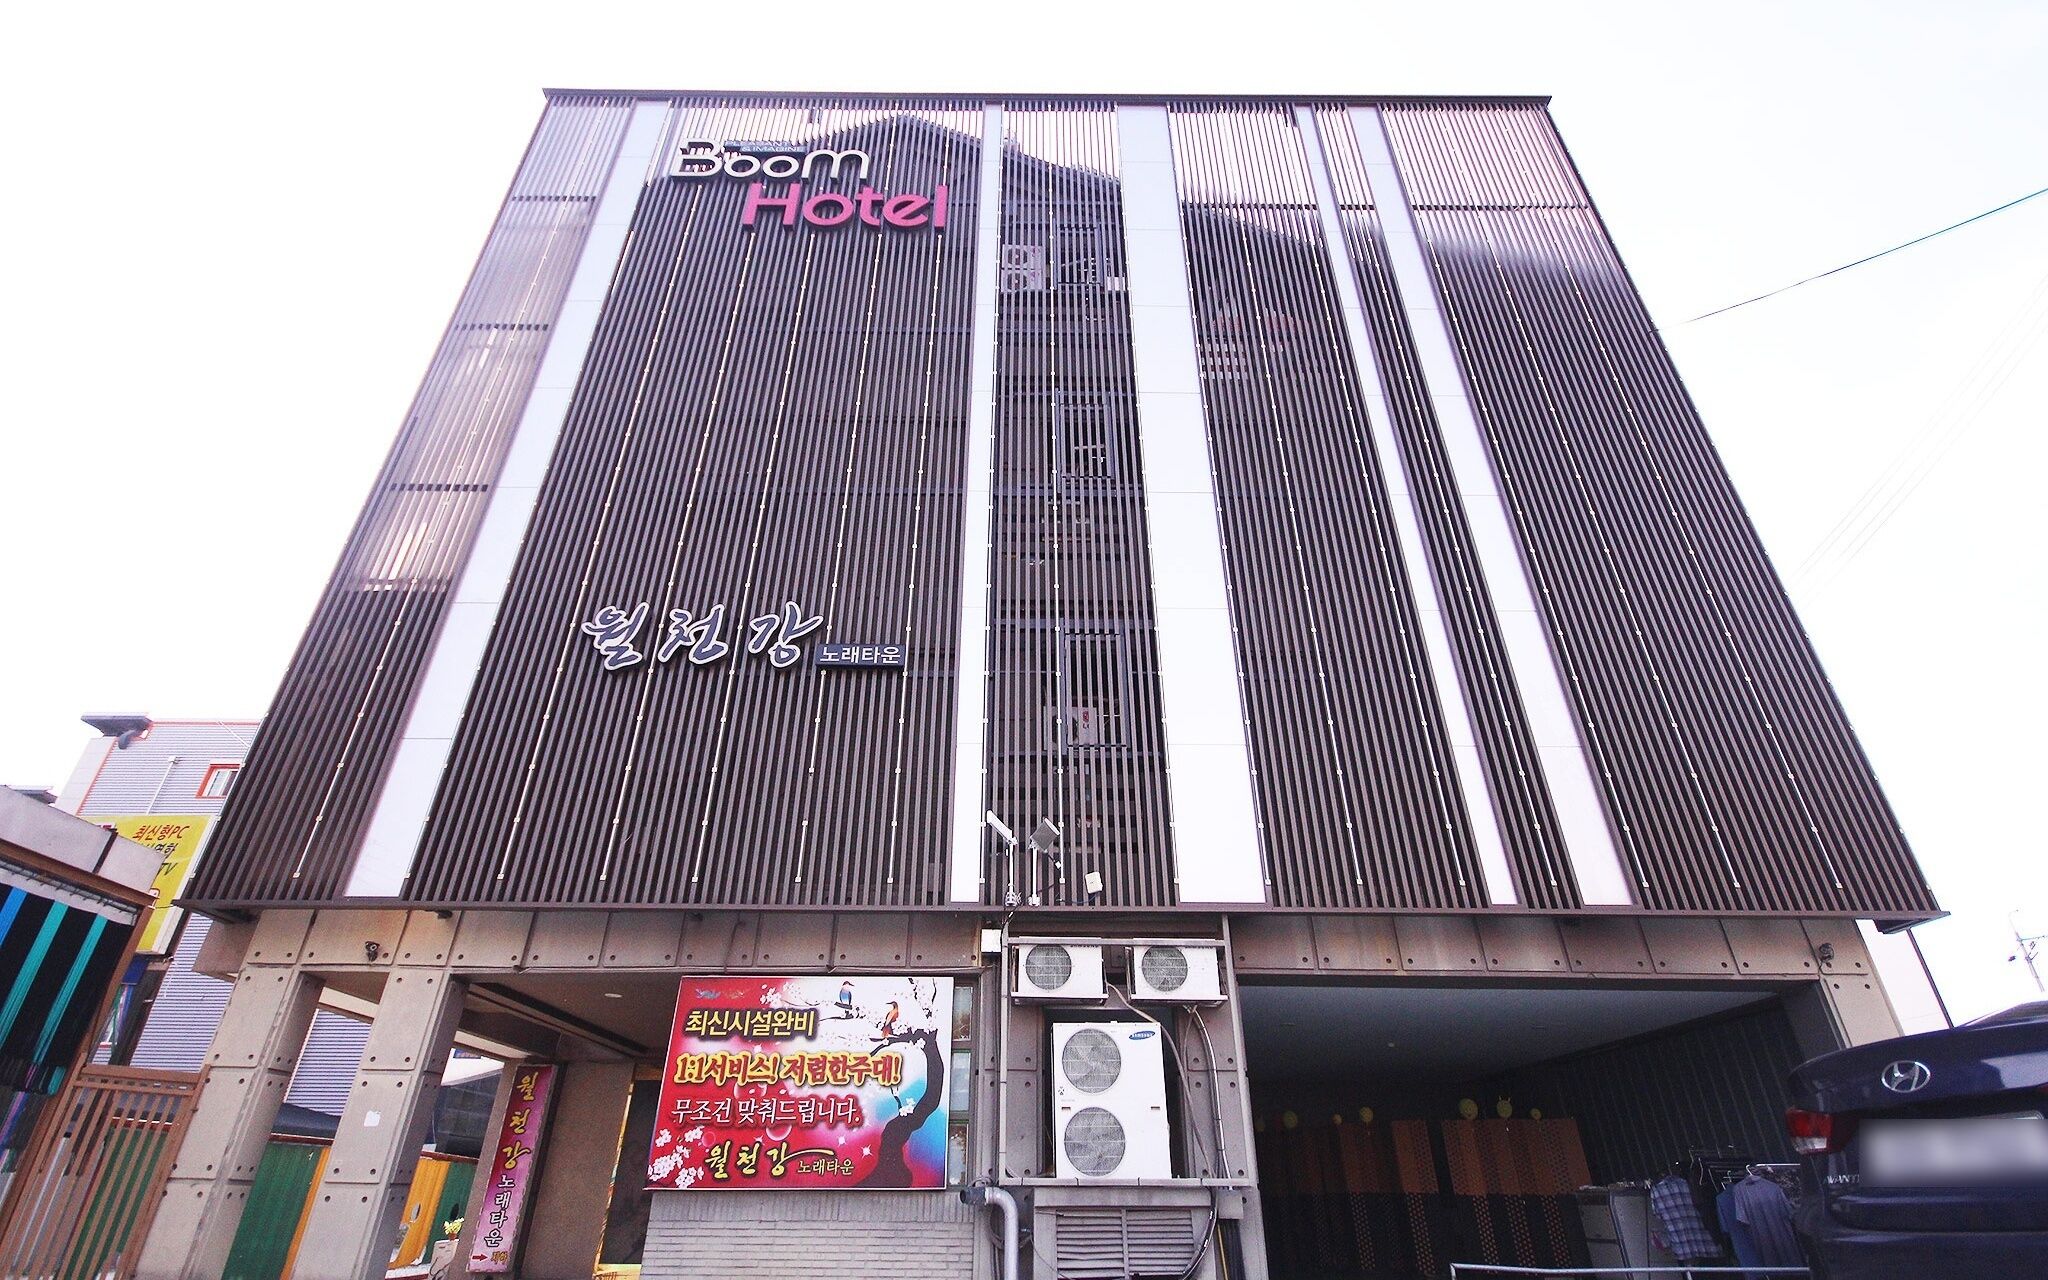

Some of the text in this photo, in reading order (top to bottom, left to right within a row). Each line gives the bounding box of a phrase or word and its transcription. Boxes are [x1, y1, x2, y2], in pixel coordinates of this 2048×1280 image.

[670, 138, 869, 183] Boom
[743, 183, 949, 228] Hotel
[819, 646, 901, 664] 노래타운
[686, 1009, 815, 1038] 최신시설완비
[779, 1051, 902, 1085] 저렴한주대!
[672, 1097, 860, 1124] 무조건 맞춰드립니다.
[798, 1159, 854, 1176] 노래타운
[1824, 1173, 1860, 1184] AVANT
[484, 1175, 515, 1247] 노래타운
